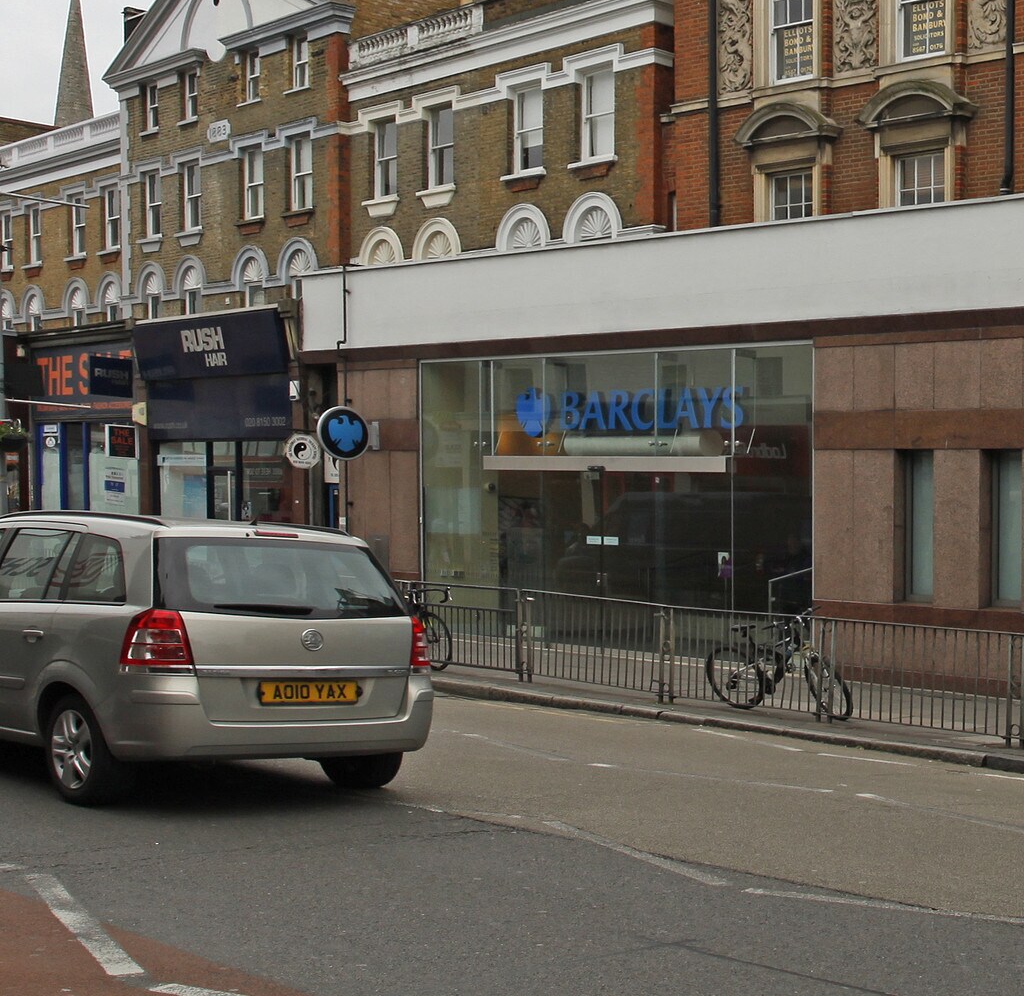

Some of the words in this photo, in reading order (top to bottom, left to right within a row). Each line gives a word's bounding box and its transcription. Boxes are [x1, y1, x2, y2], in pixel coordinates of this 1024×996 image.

[912, 11, 935, 23] BOND
[936, 9, 944, 18] &
[180, 326, 225, 353] RUSH
[204, 352, 228, 367] HAIR
[36, 355, 74, 396] THE
[94, 367, 129, 381] RUSH
[559, 385, 744, 431] BARCLAYS
[314, 684, 347, 699] YAX
